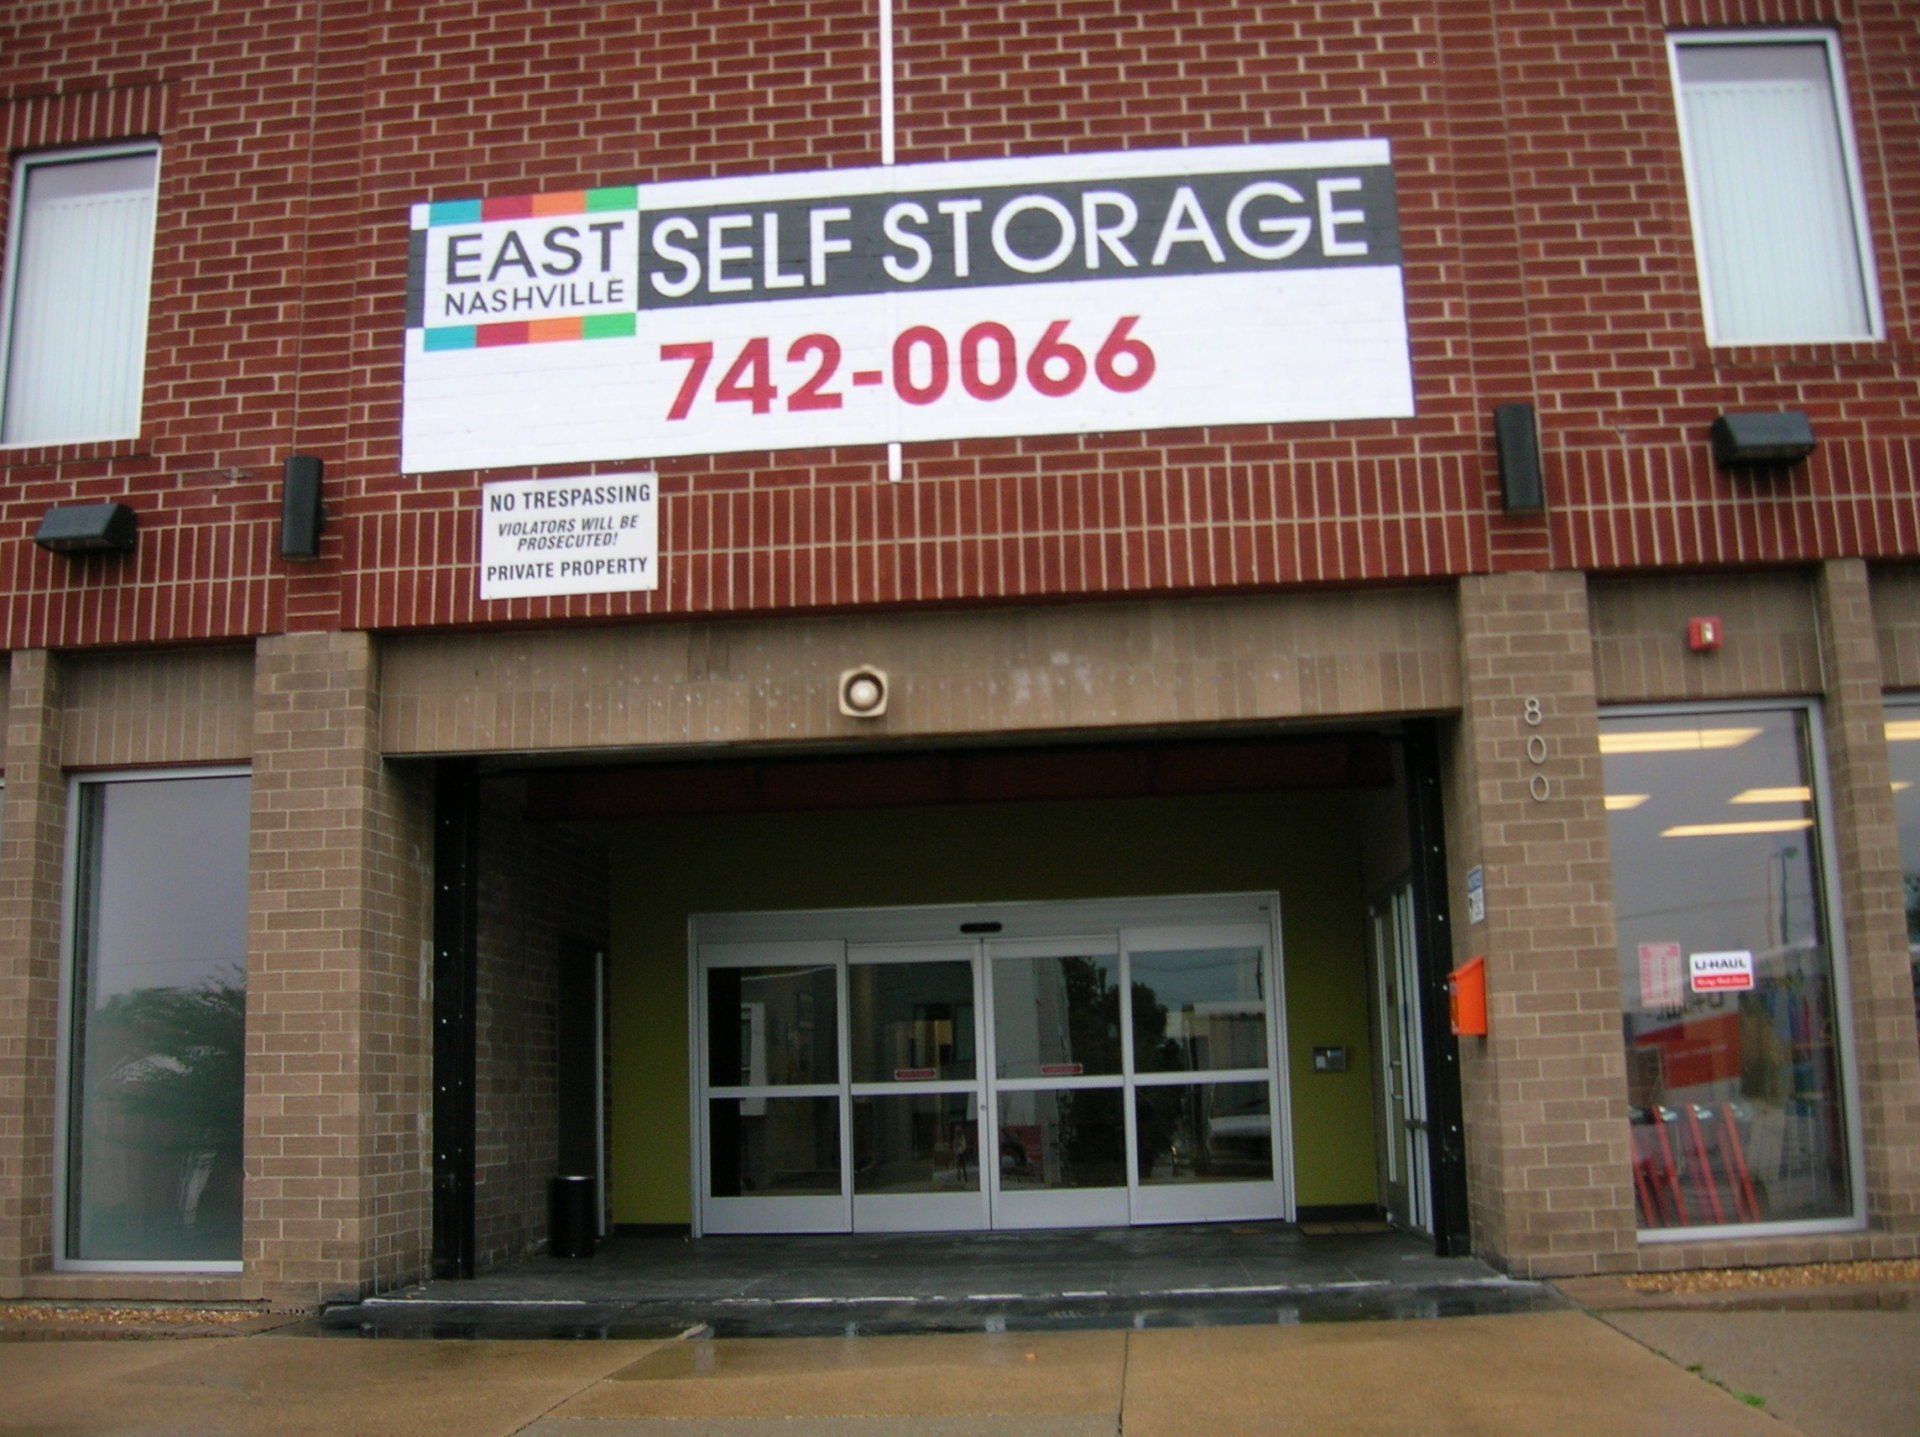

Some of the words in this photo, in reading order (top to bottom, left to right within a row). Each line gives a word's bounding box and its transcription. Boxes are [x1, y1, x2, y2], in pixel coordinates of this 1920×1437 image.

[446, 221, 624, 285] EAST
[651, 207, 852, 298] SELF
[882, 177, 1369, 284] STORAGE
[445, 279, 623, 316] NASHVILLE
[660, 315, 1156, 421] 742-0066
[490, 493, 515, 512] NO
[522, 484, 651, 510] TRESPASSING
[498, 518, 576, 537] VIOLATORS
[581, 516, 614, 531] WILL
[620, 514, 639, 529] BE
[517, 532, 618, 551] PROSECUTED!
[487, 562, 554, 581] PRIVATE
[561, 557, 648, 577] PROPERTY
[1525, 697, 1549, 802] 800
